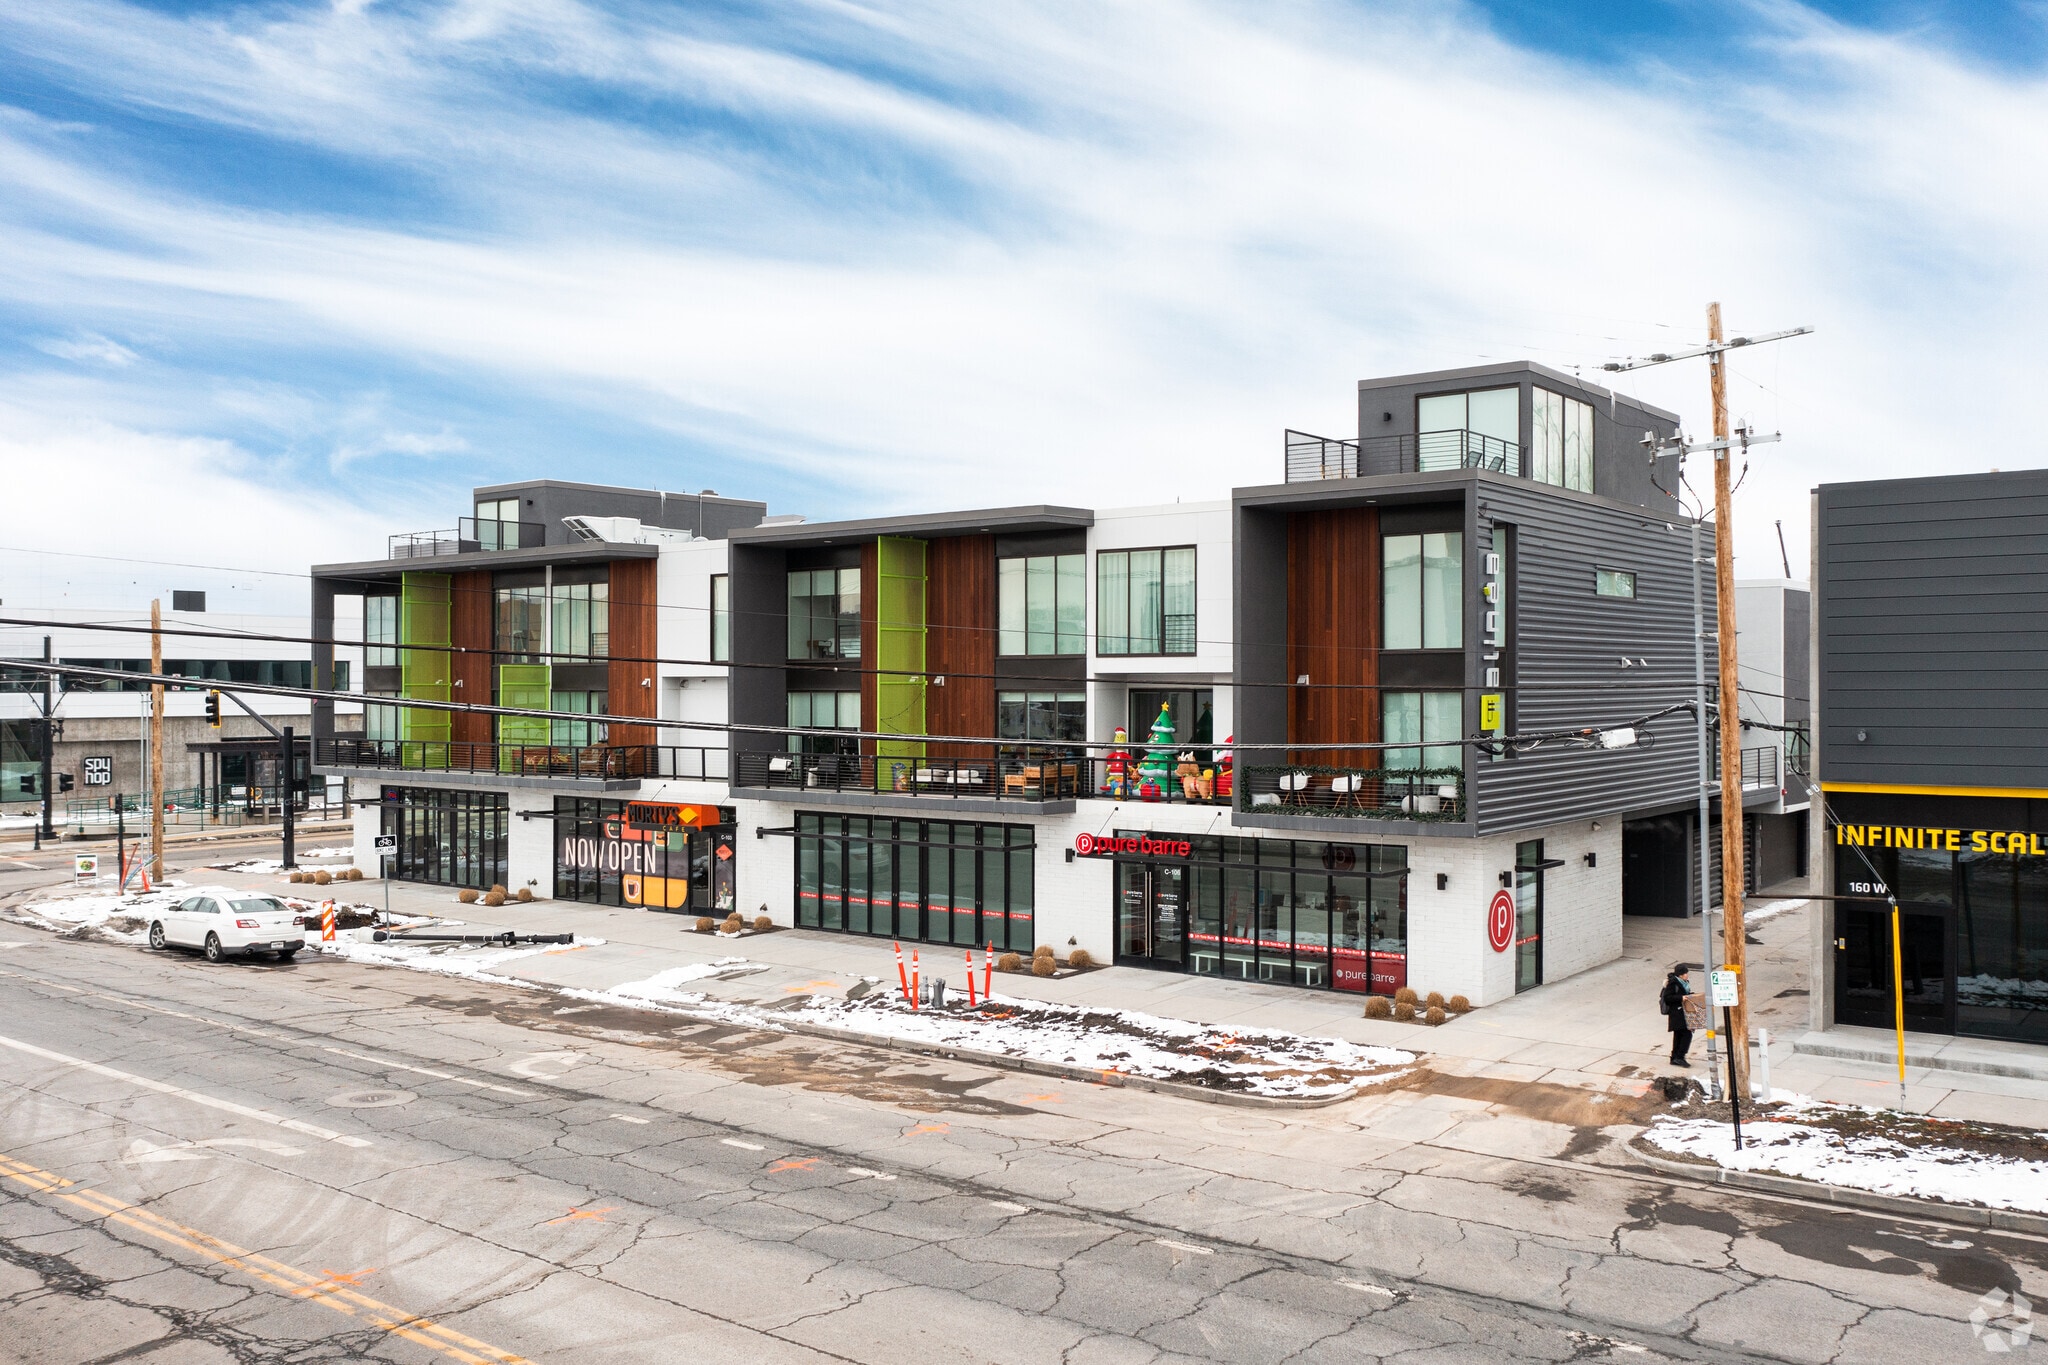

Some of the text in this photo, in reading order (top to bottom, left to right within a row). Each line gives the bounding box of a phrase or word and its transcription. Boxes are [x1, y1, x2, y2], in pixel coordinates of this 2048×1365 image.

[85, 758, 110, 772] spy
[85, 770, 111, 785] hop
[628, 804, 680, 825] MORTY'S
[1097, 837, 1138, 855] pure
[1141, 834, 1191, 856] barre
[1836, 824, 1961, 851] INFINITE
[565, 837, 656, 874] NOW OPEN
[1849, 882, 1887, 894] 160 W
[1345, 970, 1366, 980] pure
[1712, 973, 1718, 983] 2
